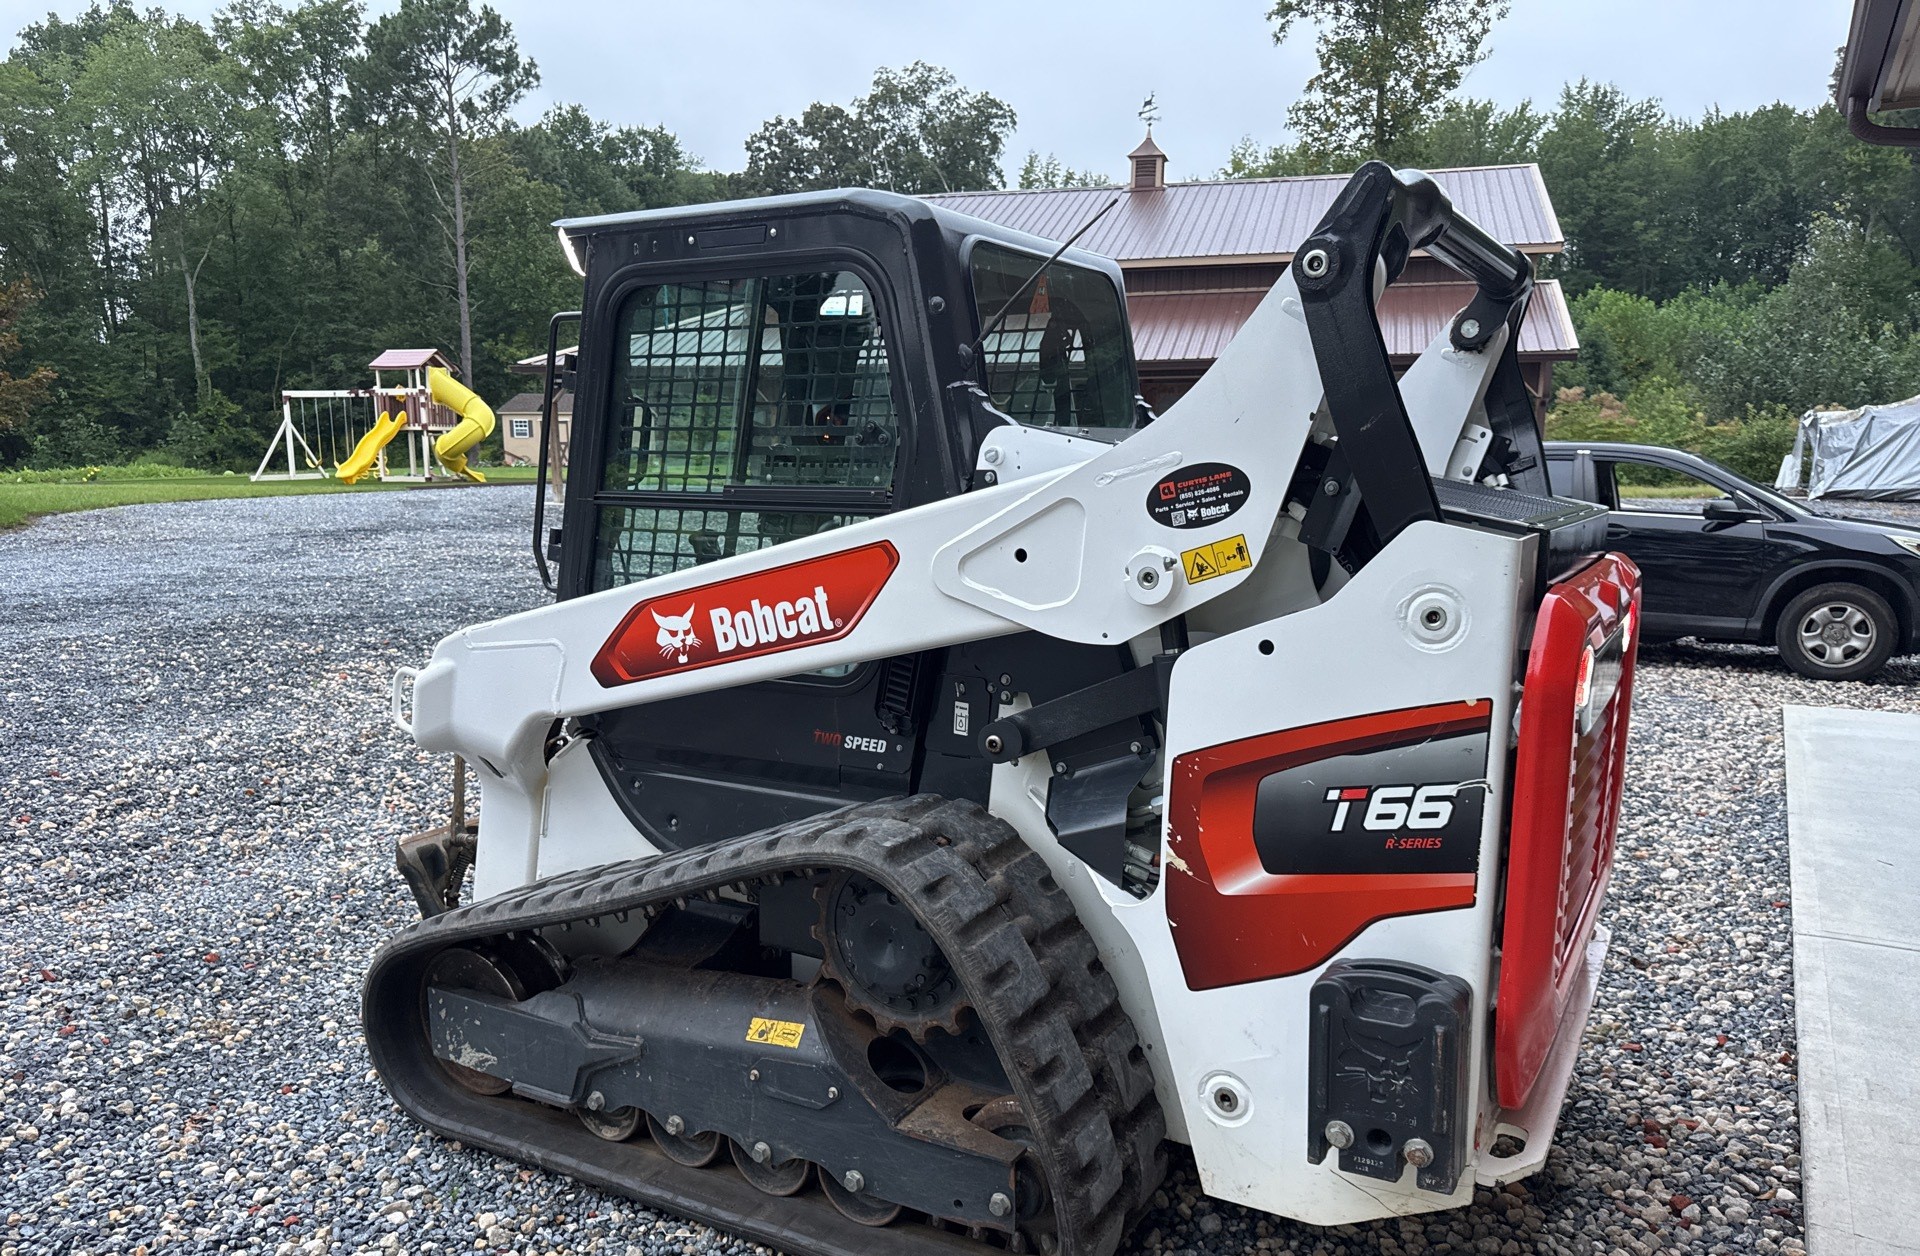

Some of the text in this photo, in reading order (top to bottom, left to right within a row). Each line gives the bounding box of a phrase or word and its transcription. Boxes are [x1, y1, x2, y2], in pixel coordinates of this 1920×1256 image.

[1177, 471, 1233, 489] CURTIS LANE
[1155, 489, 1244, 514] Parts Service Sales Rentals
[1179, 491, 1194, 501] (855)
[1200, 503, 1230, 518] Bobcat
[709, 586, 834, 653] Bobcat
[813, 728, 887, 753] TWO SPEED
[1326, 784, 1459, 832] T66
[1385, 837, 1443, 850] R-SERIES
